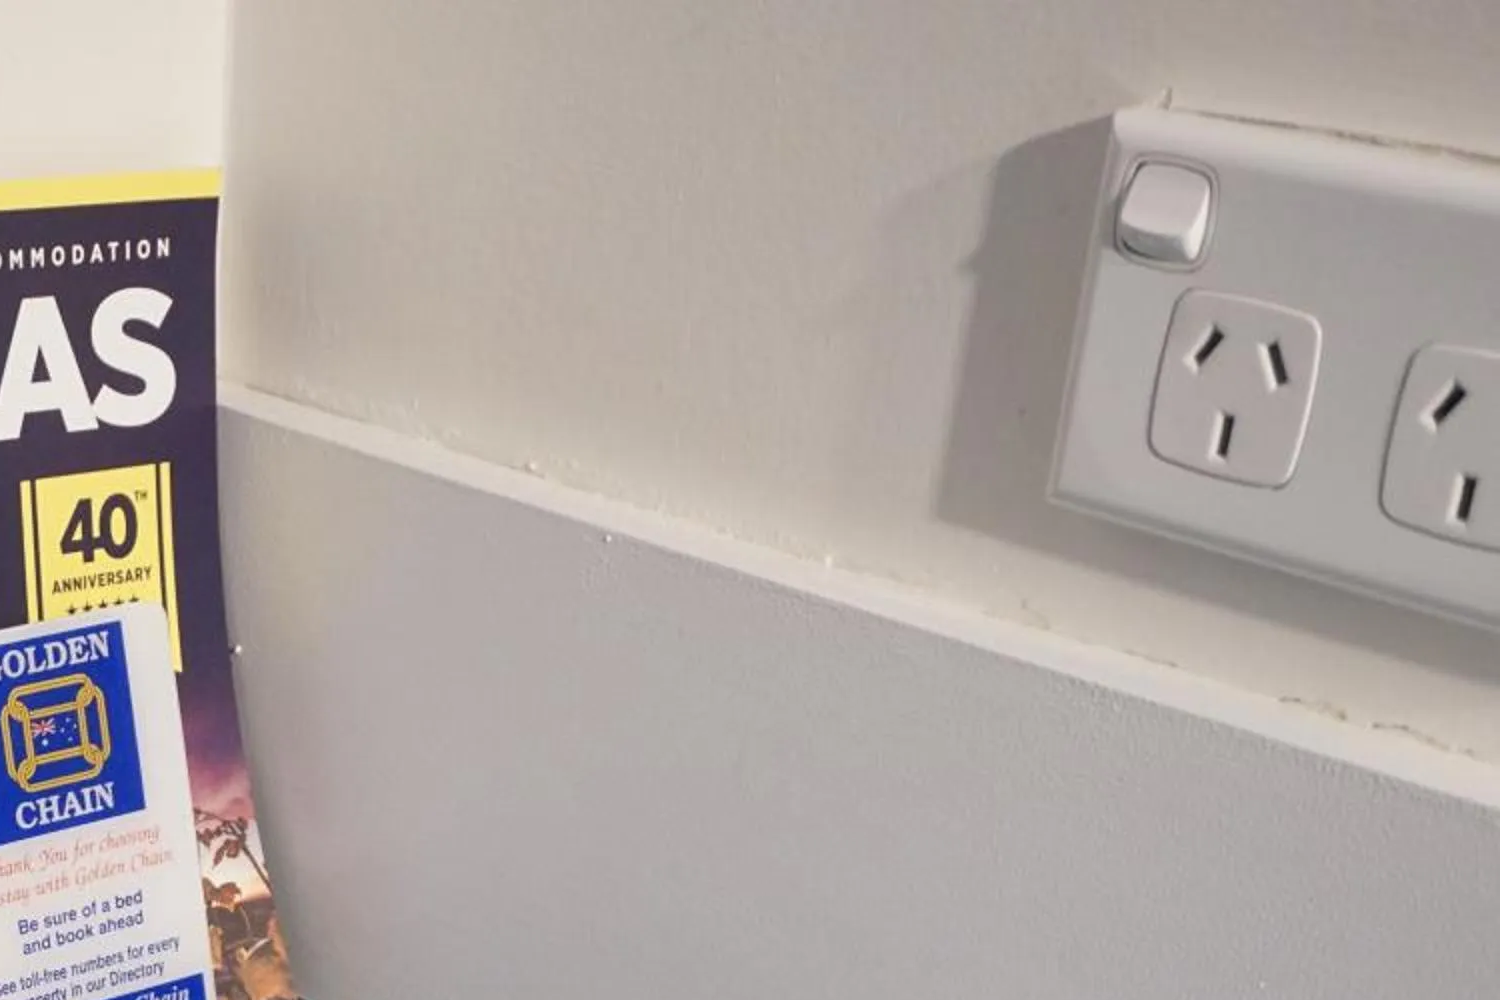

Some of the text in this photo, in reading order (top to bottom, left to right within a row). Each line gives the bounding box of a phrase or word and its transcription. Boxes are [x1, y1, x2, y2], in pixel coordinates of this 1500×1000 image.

[52, 565, 152, 595] ANNIVERSARY
[15, 781, 115, 829] CHAIN
[38, 845, 68, 871] You
[71, 838, 95, 865] for
[99, 826, 161, 850] choosing
[35, 875, 69, 896] with
[74, 861, 126, 888] Golden
[17, 890, 143, 936] Be sure of a bed
[22, 911, 145, 956] and book ahead
[19, 966, 67, 992] toll-free
[71, 951, 125, 977] numbers
[127, 944, 144, 960] for
[147, 935, 180, 957] every
[71, 982, 84, 998] in
[86, 976, 107, 993] our
[110, 960, 165, 988] Directory
